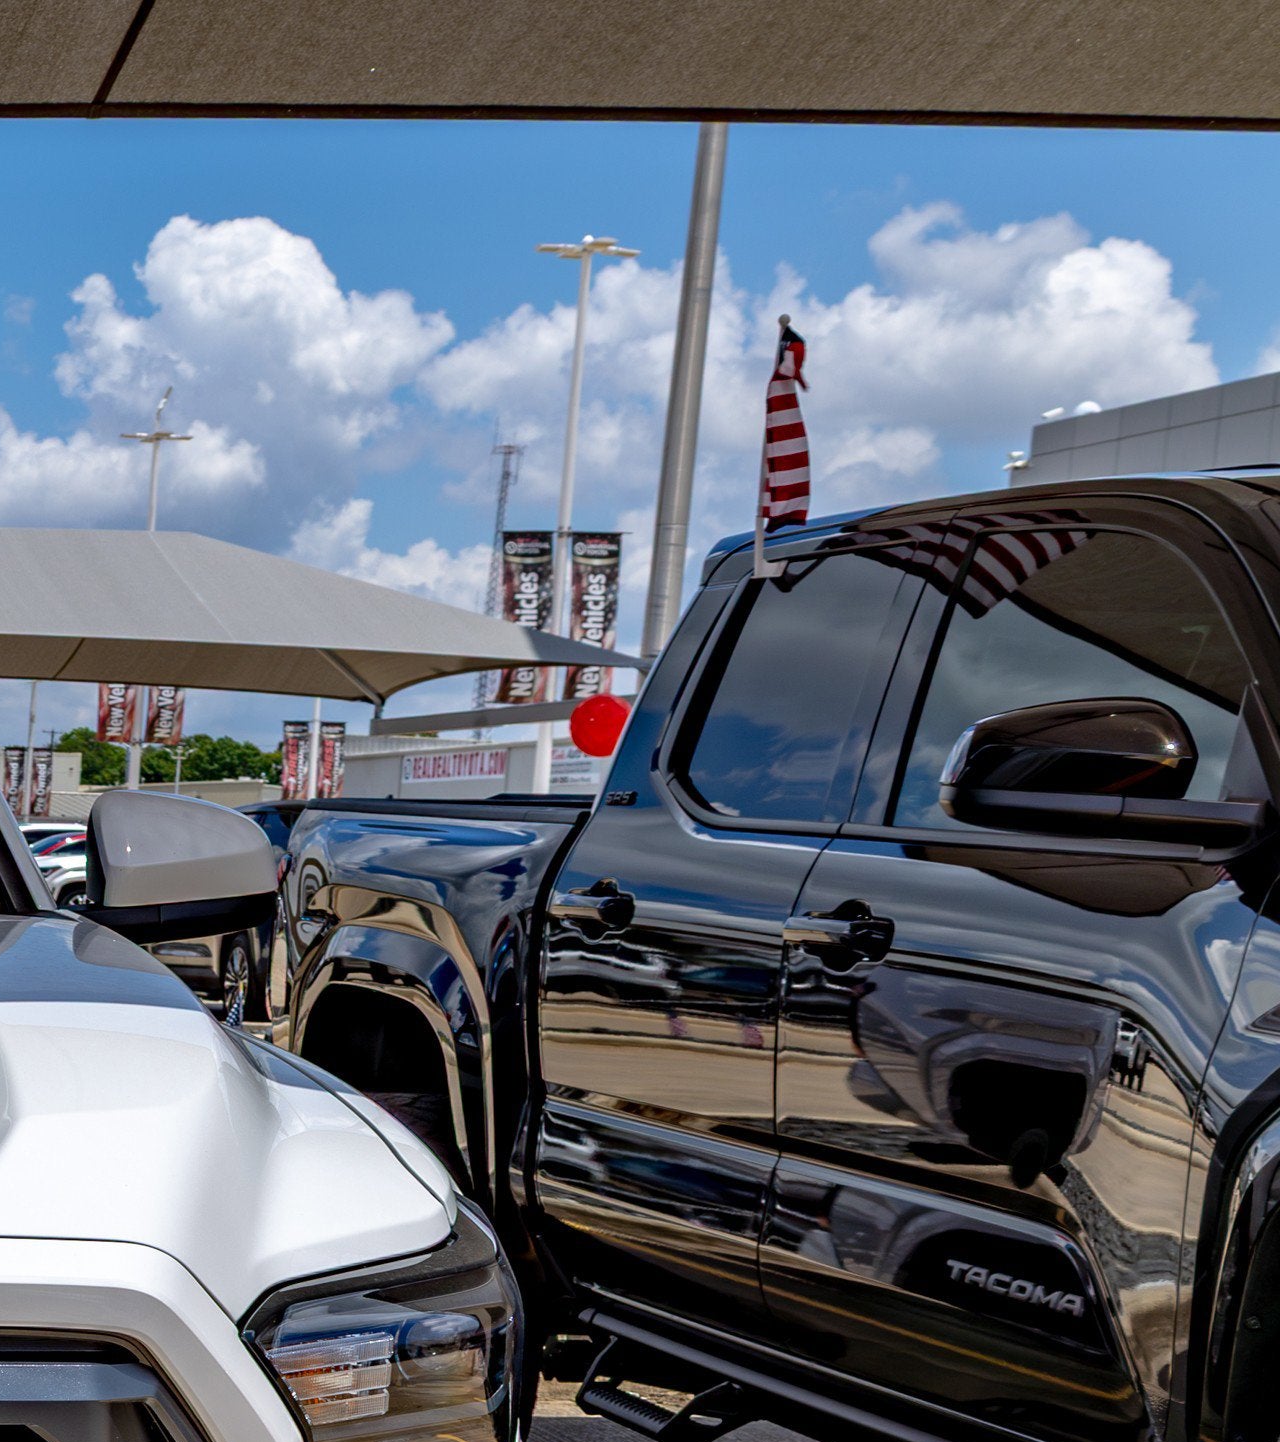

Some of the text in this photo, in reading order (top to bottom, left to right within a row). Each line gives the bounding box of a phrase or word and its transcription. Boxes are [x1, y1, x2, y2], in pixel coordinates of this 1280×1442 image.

[106, 707, 124, 737] New
[154, 709, 173, 738] New
[947, 1259, 1085, 1318] TACOMA
